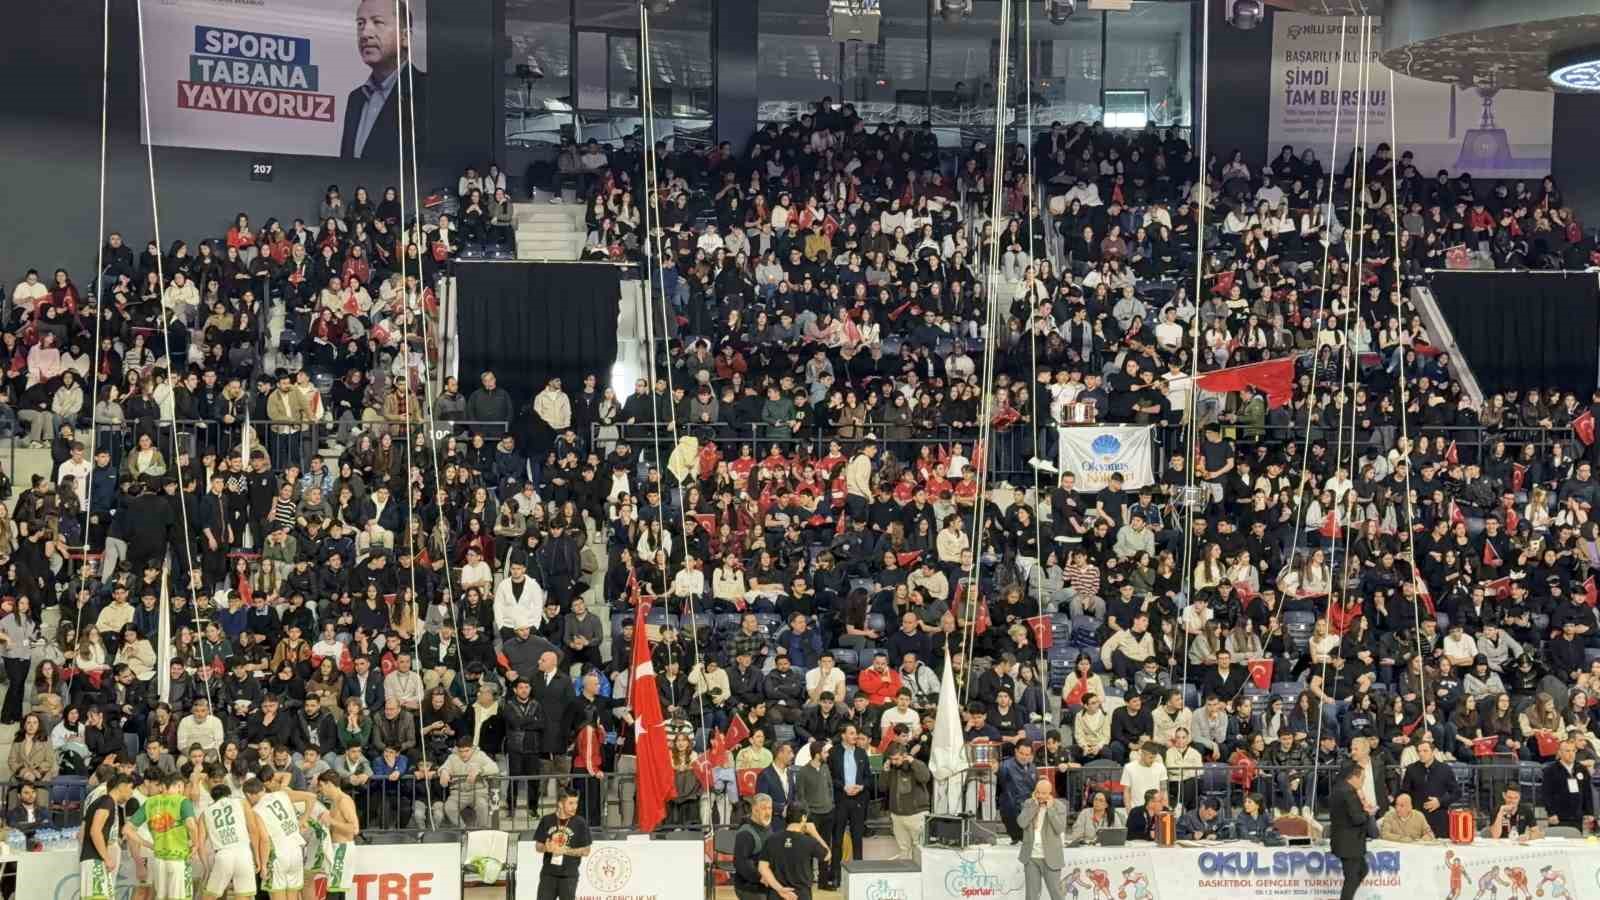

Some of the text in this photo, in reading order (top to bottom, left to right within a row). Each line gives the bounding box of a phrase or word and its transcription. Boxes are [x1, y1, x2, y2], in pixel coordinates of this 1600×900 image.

[205, 30, 296, 62] SPORU
[197, 59, 308, 89] TABANA
[182, 84, 331, 120] YAYIYORUZ
[1286, 89, 1386, 106] TAM BURSLU!
[253, 164, 272, 174] 207
[212, 804, 235, 829] 22
[266, 799, 289, 821] 13
[1198, 850, 1400, 876] OKUL SPORARI
[352, 872, 434, 900] TBF
